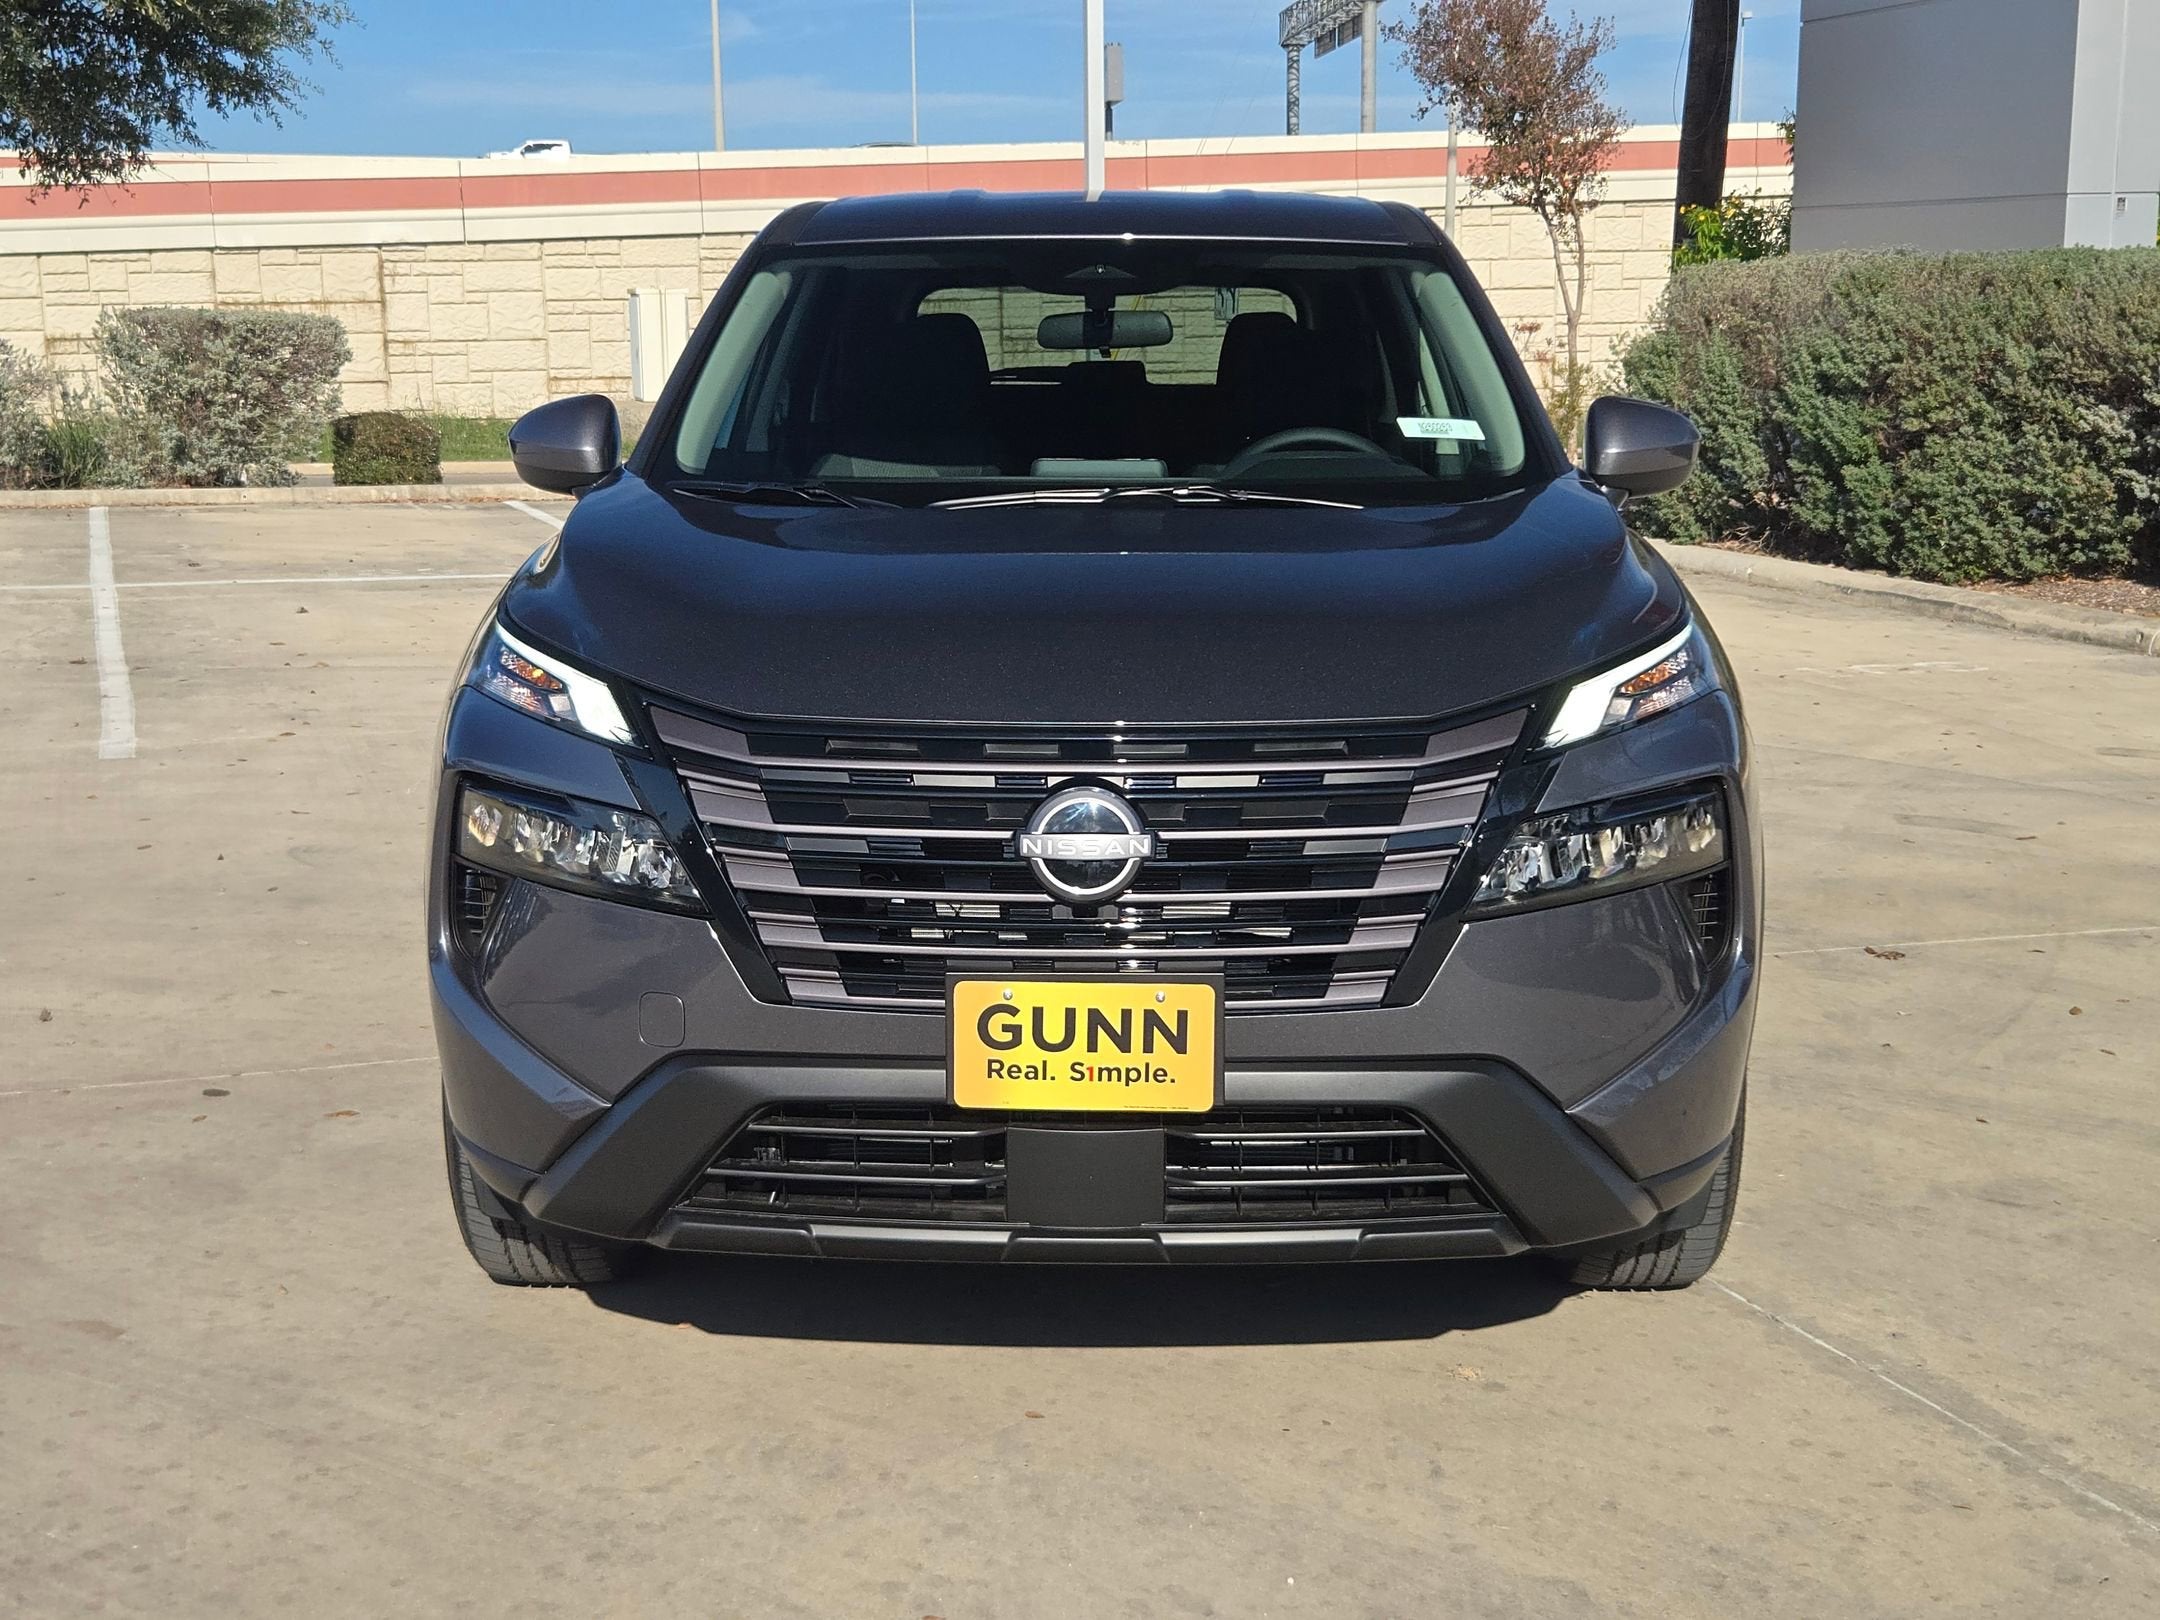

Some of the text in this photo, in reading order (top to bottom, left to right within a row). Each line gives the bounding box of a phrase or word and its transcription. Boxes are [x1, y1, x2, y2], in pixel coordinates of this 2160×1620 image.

[1022, 838, 1149, 856] NISSAN
[977, 1003, 1188, 1055] GUNN
[987, 1058, 1056, 1081] Real.
